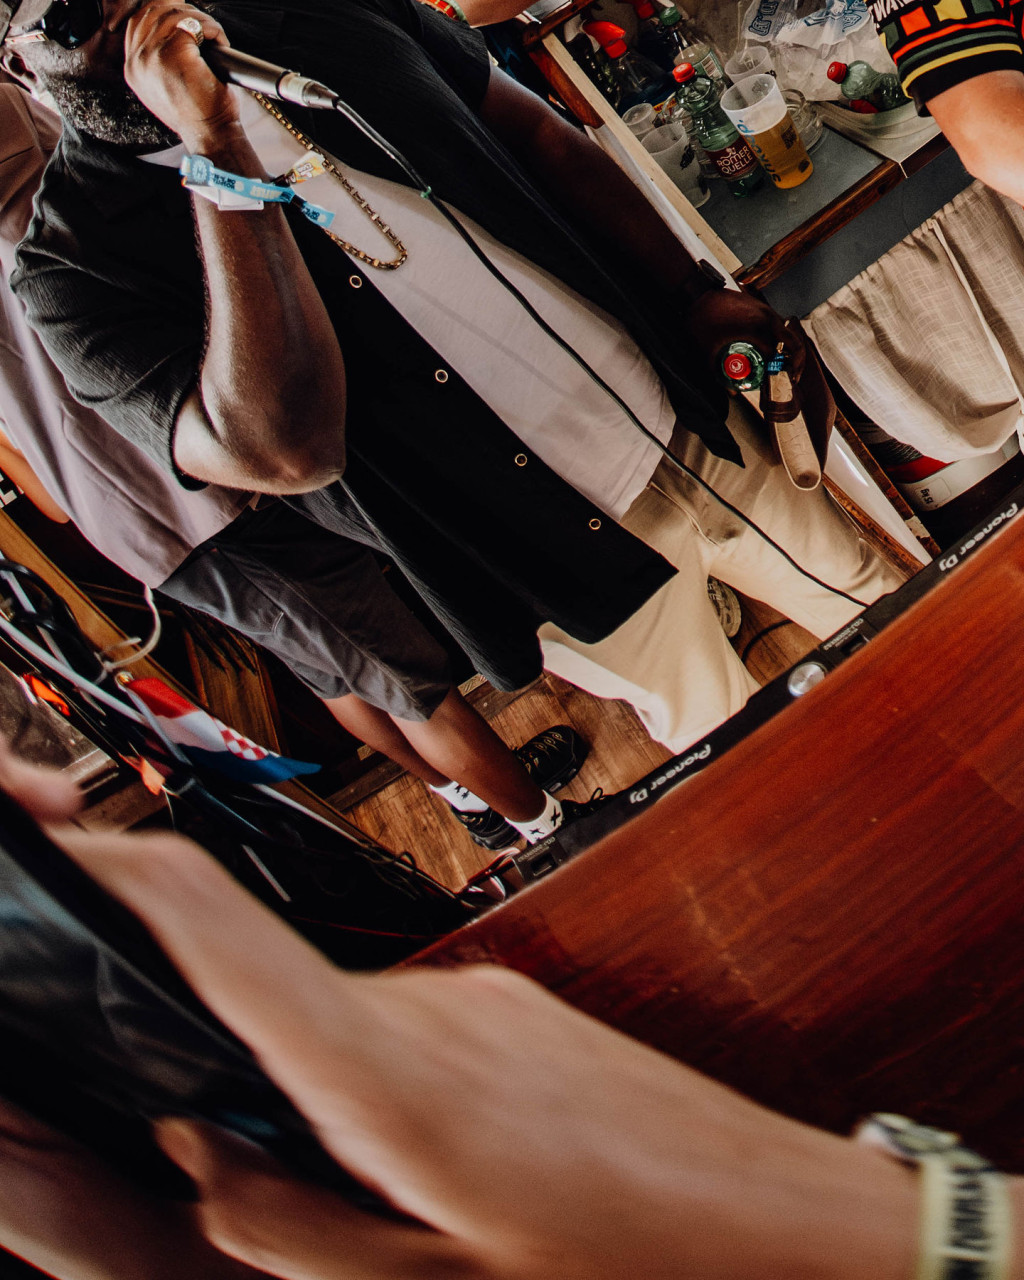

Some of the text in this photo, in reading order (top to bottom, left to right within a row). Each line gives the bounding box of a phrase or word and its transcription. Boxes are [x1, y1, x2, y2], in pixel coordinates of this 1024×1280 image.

[721, 154, 753, 174] QUELLE
[960, 503, 1018, 556] Pioneer
[651, 743, 712, 791] Pioneer
